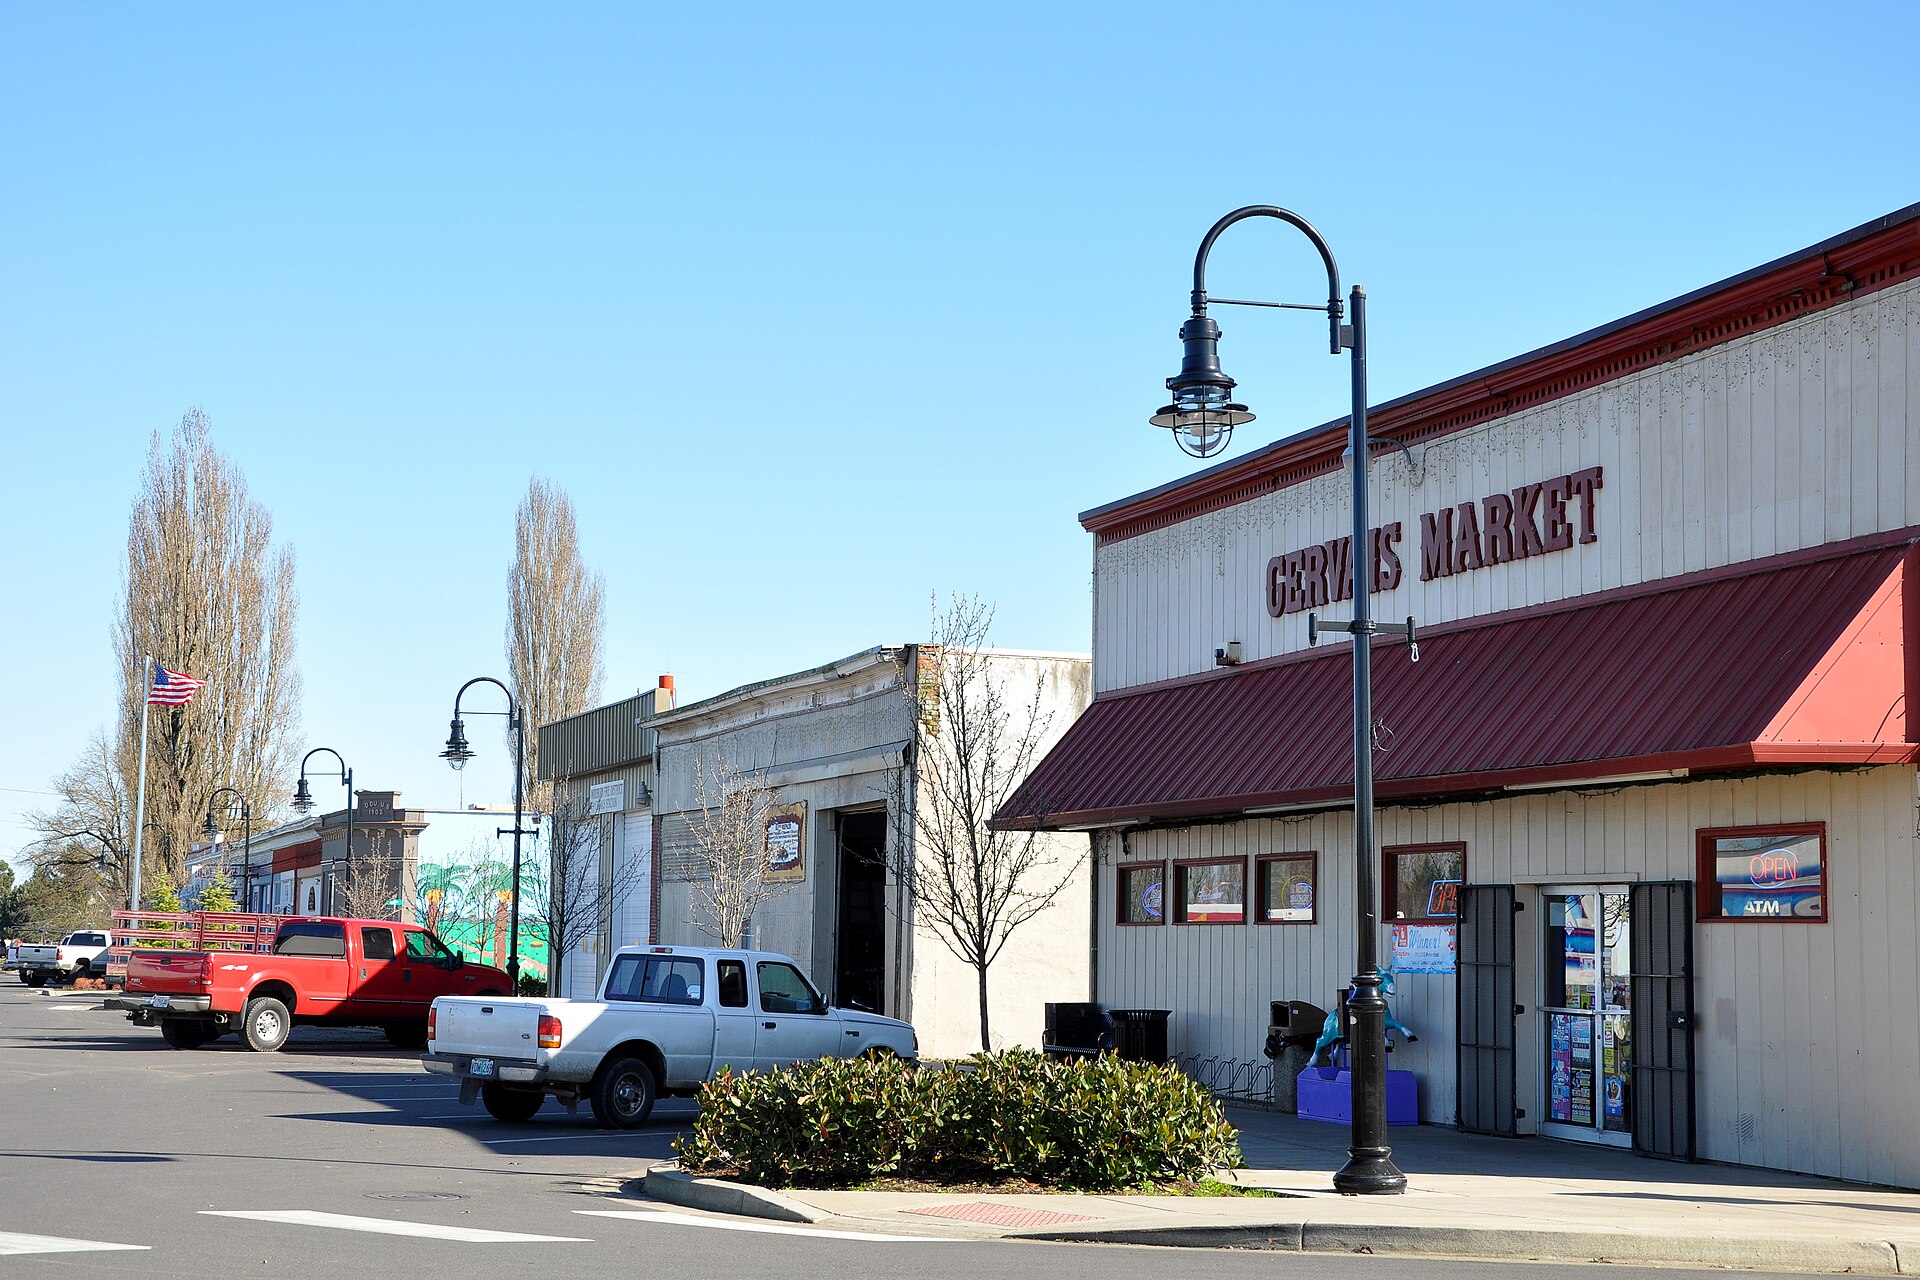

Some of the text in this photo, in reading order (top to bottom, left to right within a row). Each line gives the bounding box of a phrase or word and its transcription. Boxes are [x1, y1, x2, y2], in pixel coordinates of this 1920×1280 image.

[1419, 466, 1604, 581] MARKET
[1749, 856, 1798, 881] OPEN
[1431, 883, 1462, 912] OPE
[1743, 900, 1780, 914] ATM
[1408, 929, 1441, 949] Winner!
